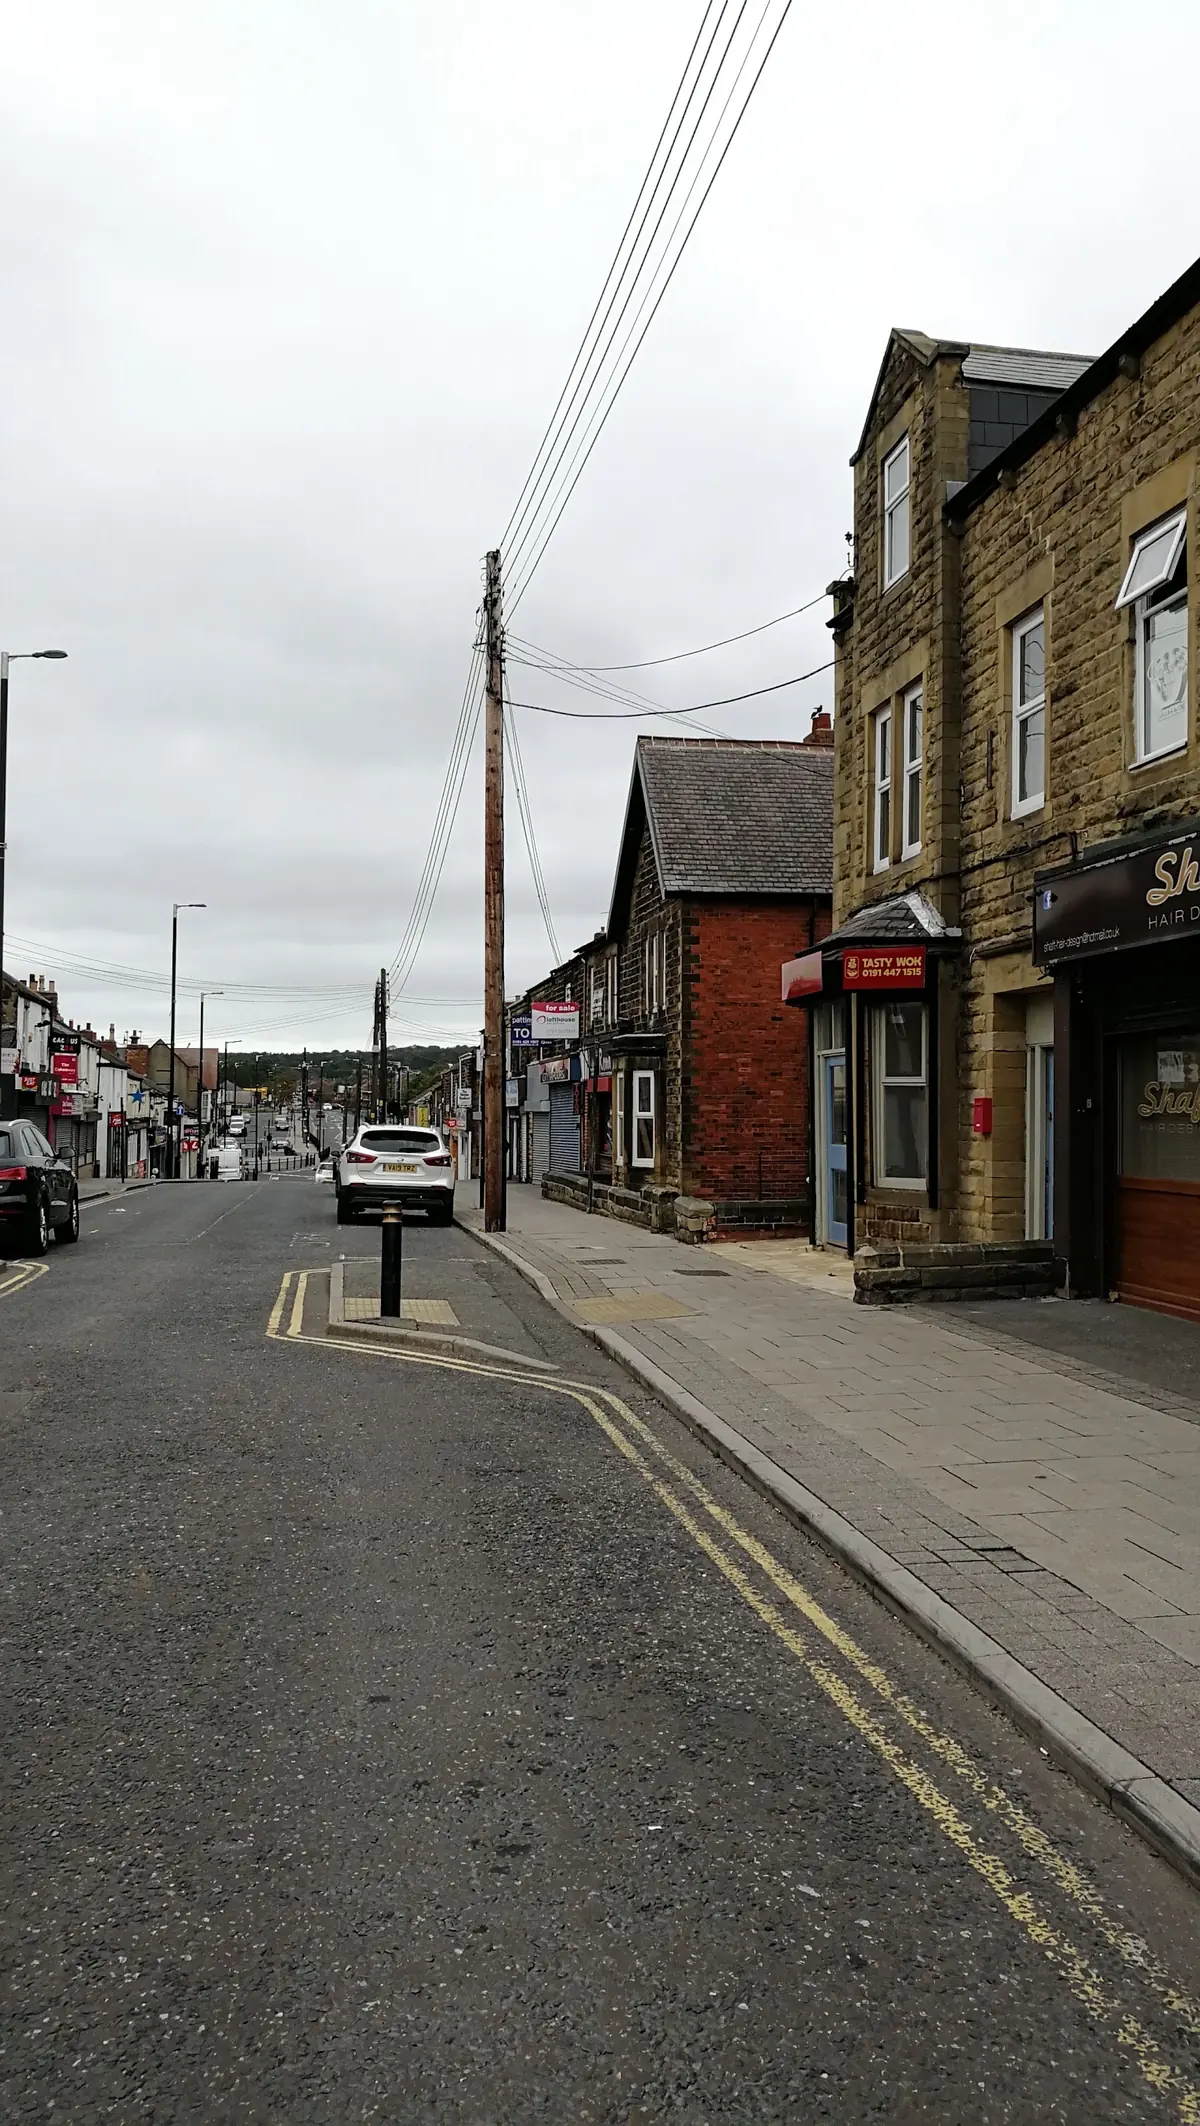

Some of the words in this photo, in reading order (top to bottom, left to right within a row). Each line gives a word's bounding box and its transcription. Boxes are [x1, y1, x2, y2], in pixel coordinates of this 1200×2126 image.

[1146, 848, 1200, 906] Sh
[1148, 909, 1185, 930] HAIR
[862, 958, 893, 970] TASTY
[896, 956, 922, 968] WOK
[862, 968, 882, 978] 0191
[883, 968, 901, 977] 447
[902, 967, 922, 977] 1515
[545, 1004, 557, 1012] for
[558, 1004, 576, 1012] sale
[512, 1016, 532, 1025] pattin
[513, 1028, 530, 1039] TO
[403, 1164, 416, 1172] TRZ
